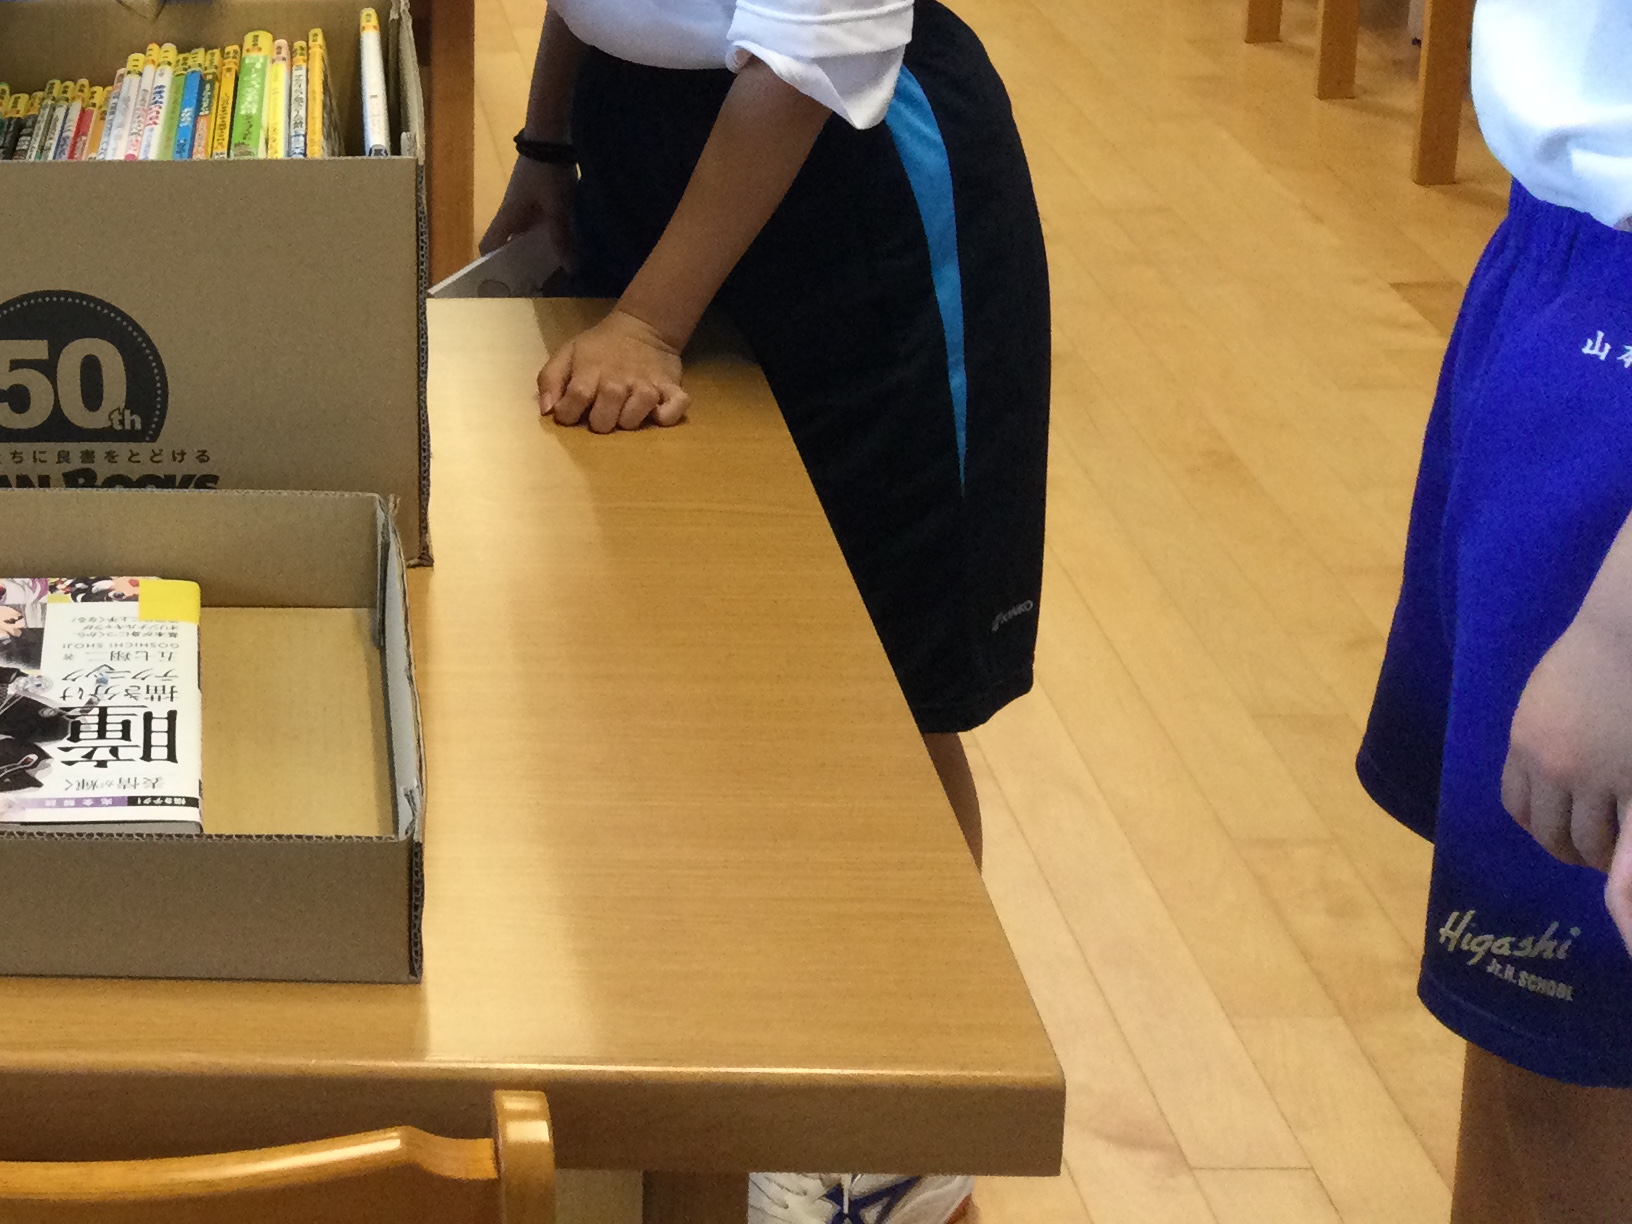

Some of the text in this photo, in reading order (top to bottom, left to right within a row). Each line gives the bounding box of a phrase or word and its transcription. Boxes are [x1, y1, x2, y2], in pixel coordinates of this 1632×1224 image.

[59, 683, 179, 702] 描き分け
[57, 705, 179, 769] 瞳
[63, 776, 164, 791] 表情が輝く
[1438, 909, 1582, 966] Higashi
